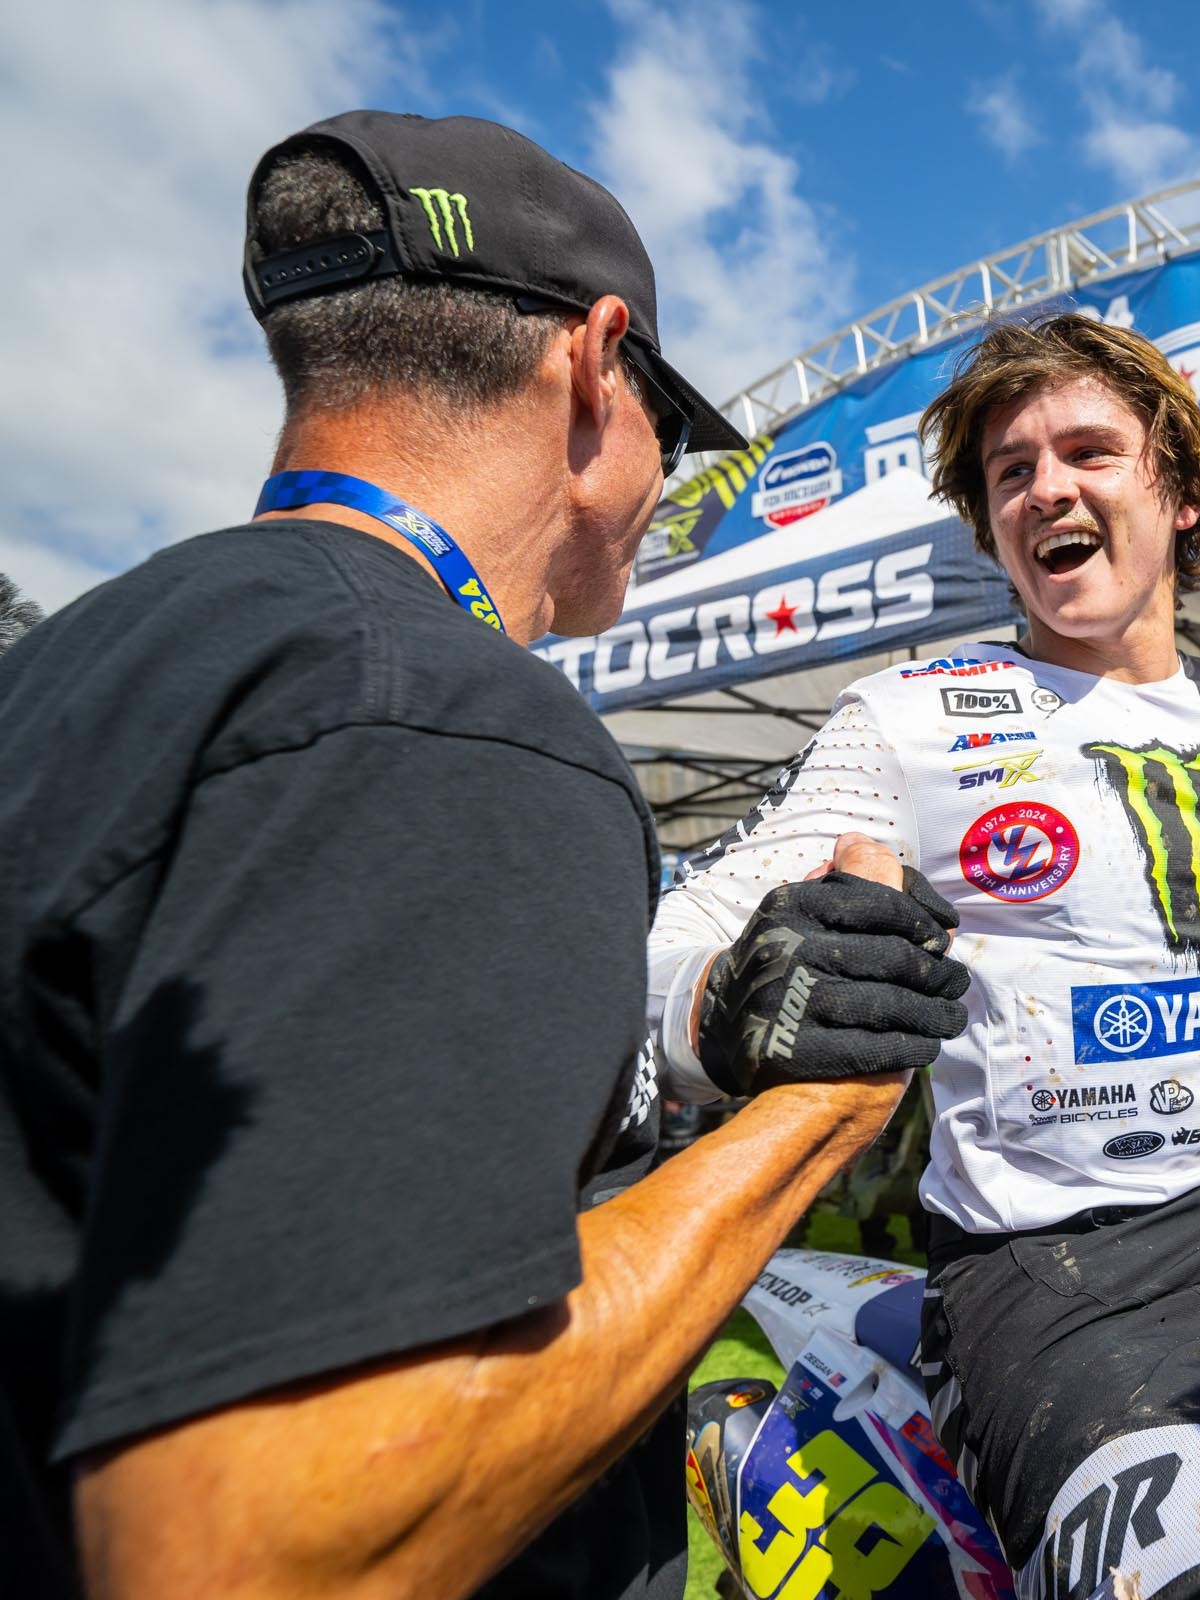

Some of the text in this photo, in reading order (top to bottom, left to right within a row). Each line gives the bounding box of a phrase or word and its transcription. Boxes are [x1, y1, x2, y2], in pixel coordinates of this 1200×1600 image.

[536, 543, 935, 694] TOCROSS
[953, 693, 1009, 709] 100%
[947, 732, 1006, 753] AMA
[958, 755, 1041, 790] SMX
[981, 814, 1006, 833] 1974
[1020, 809, 1046, 821] 2024
[970, 846, 1071, 896] 50TH ANNIVERSARY
[766, 966, 819, 1060] THOR
[1056, 1083, 1137, 1109] YAMAHA
[1060, 1107, 1139, 1125] BICYCLES
[759, 1271, 814, 1307] UNLOP
[803, 1352, 833, 1377] DEEGAN
[740, 1428, 939, 1600] 38
